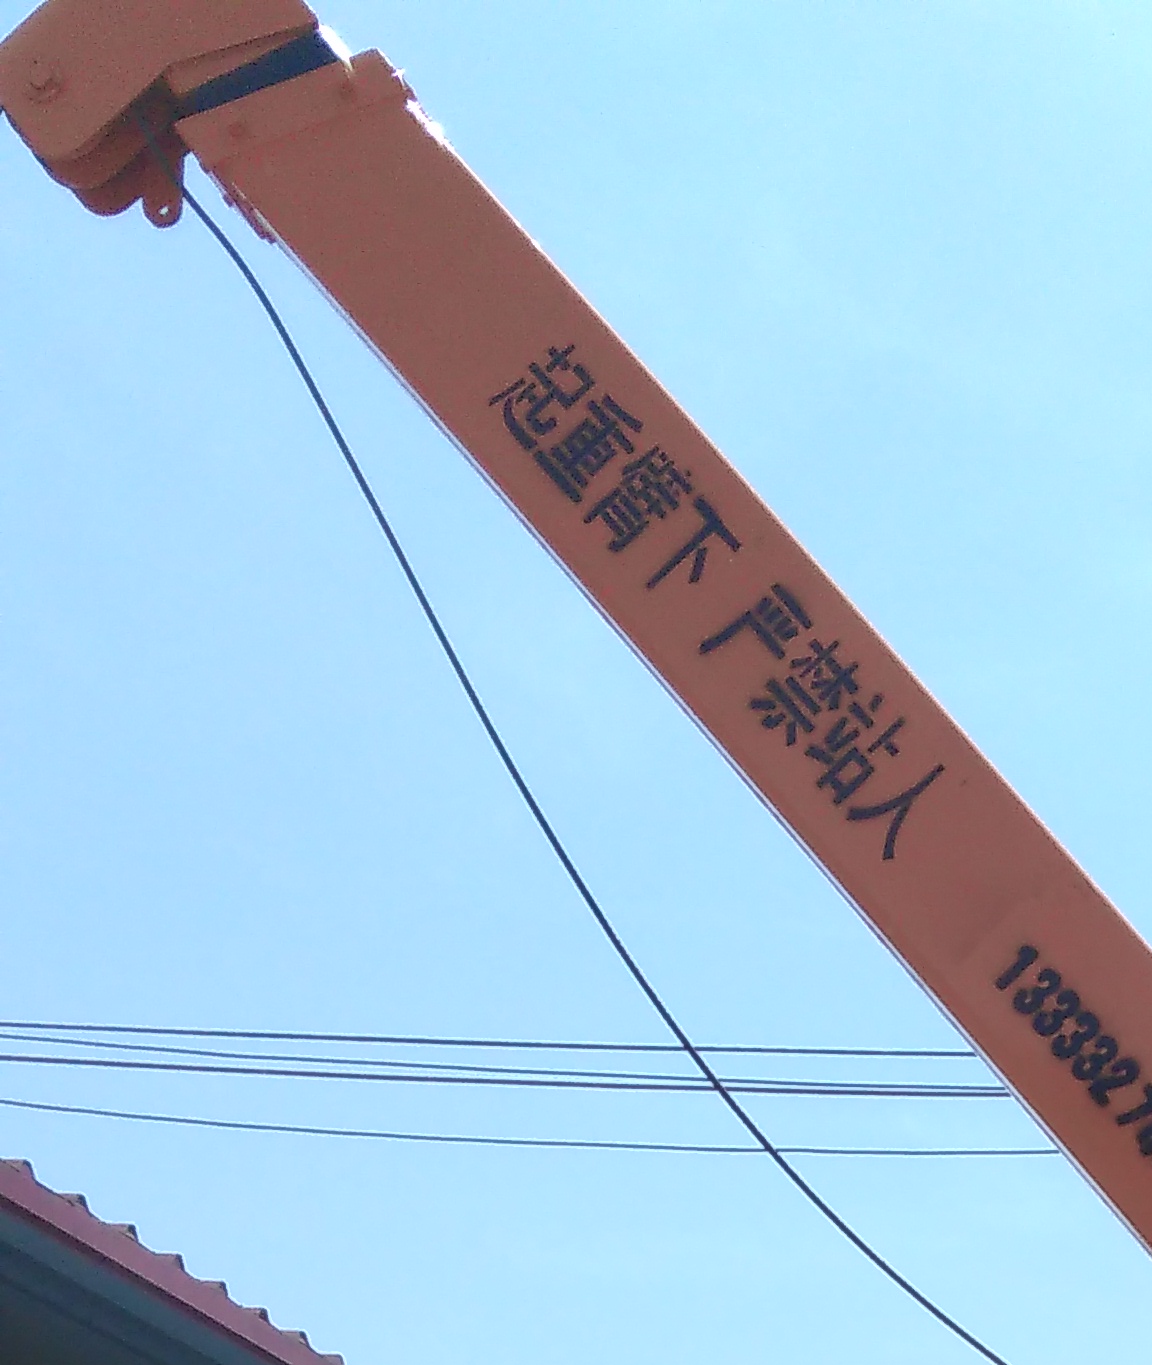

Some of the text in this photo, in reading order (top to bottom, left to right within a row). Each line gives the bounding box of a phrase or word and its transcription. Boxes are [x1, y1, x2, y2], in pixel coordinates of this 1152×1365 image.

[489, 344, 946, 861] 起重臂下 严禁站人
